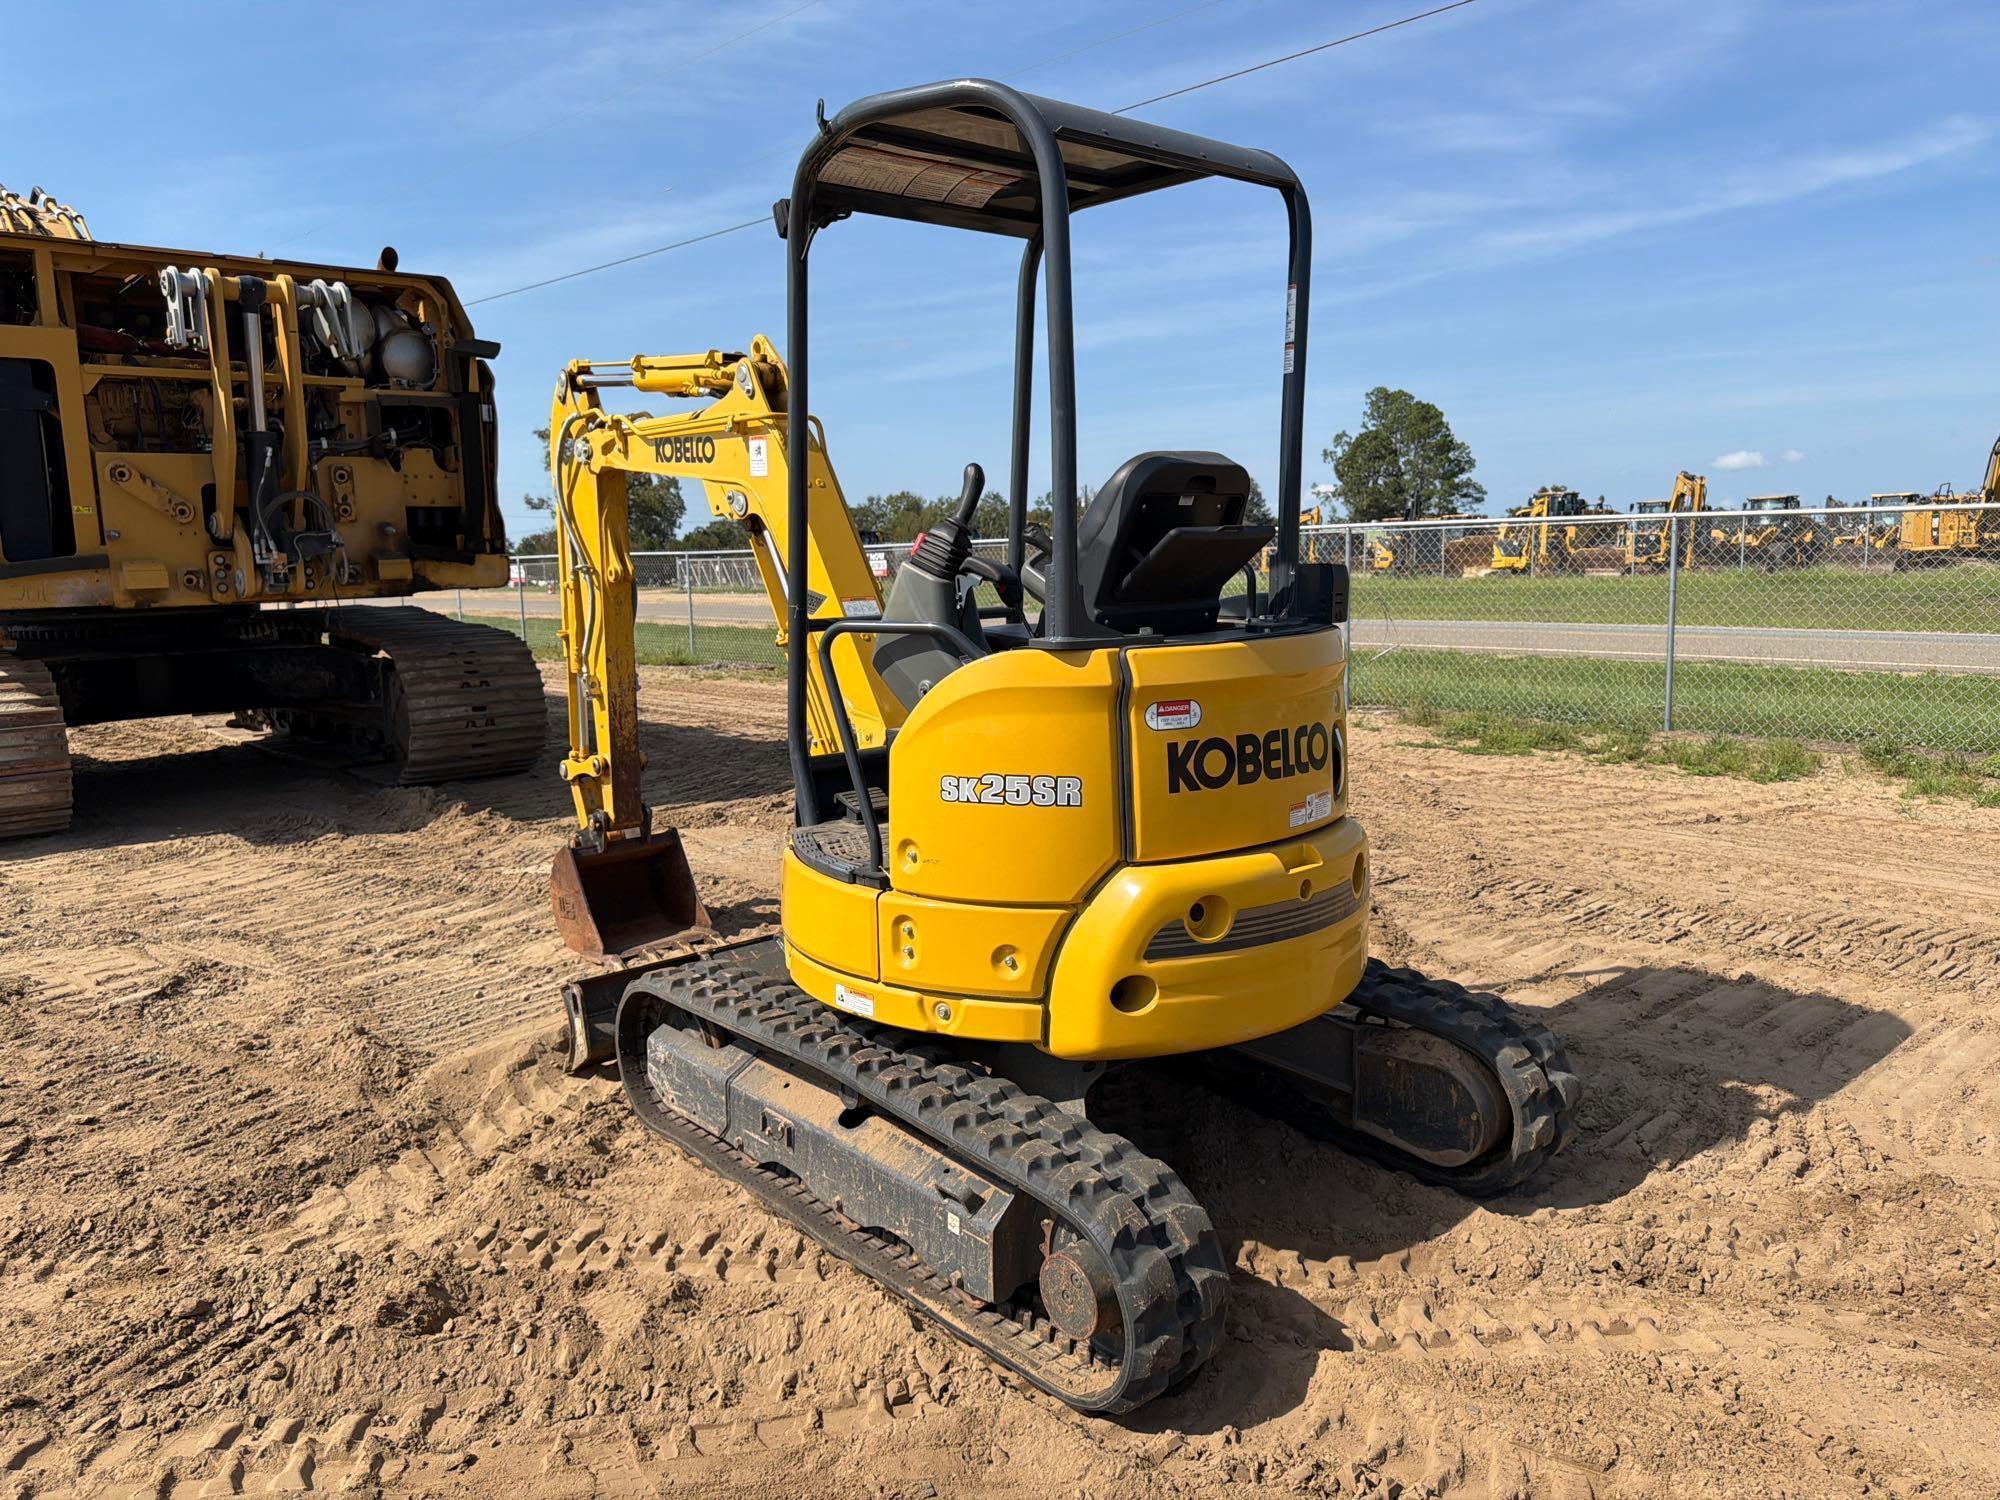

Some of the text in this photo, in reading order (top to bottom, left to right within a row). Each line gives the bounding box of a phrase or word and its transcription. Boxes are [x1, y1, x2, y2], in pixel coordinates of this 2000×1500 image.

[655, 436, 715, 463] KOBELCO
[1167, 722, 1328, 794] KOBELCO
[941, 773, 1082, 807] SK25SR
